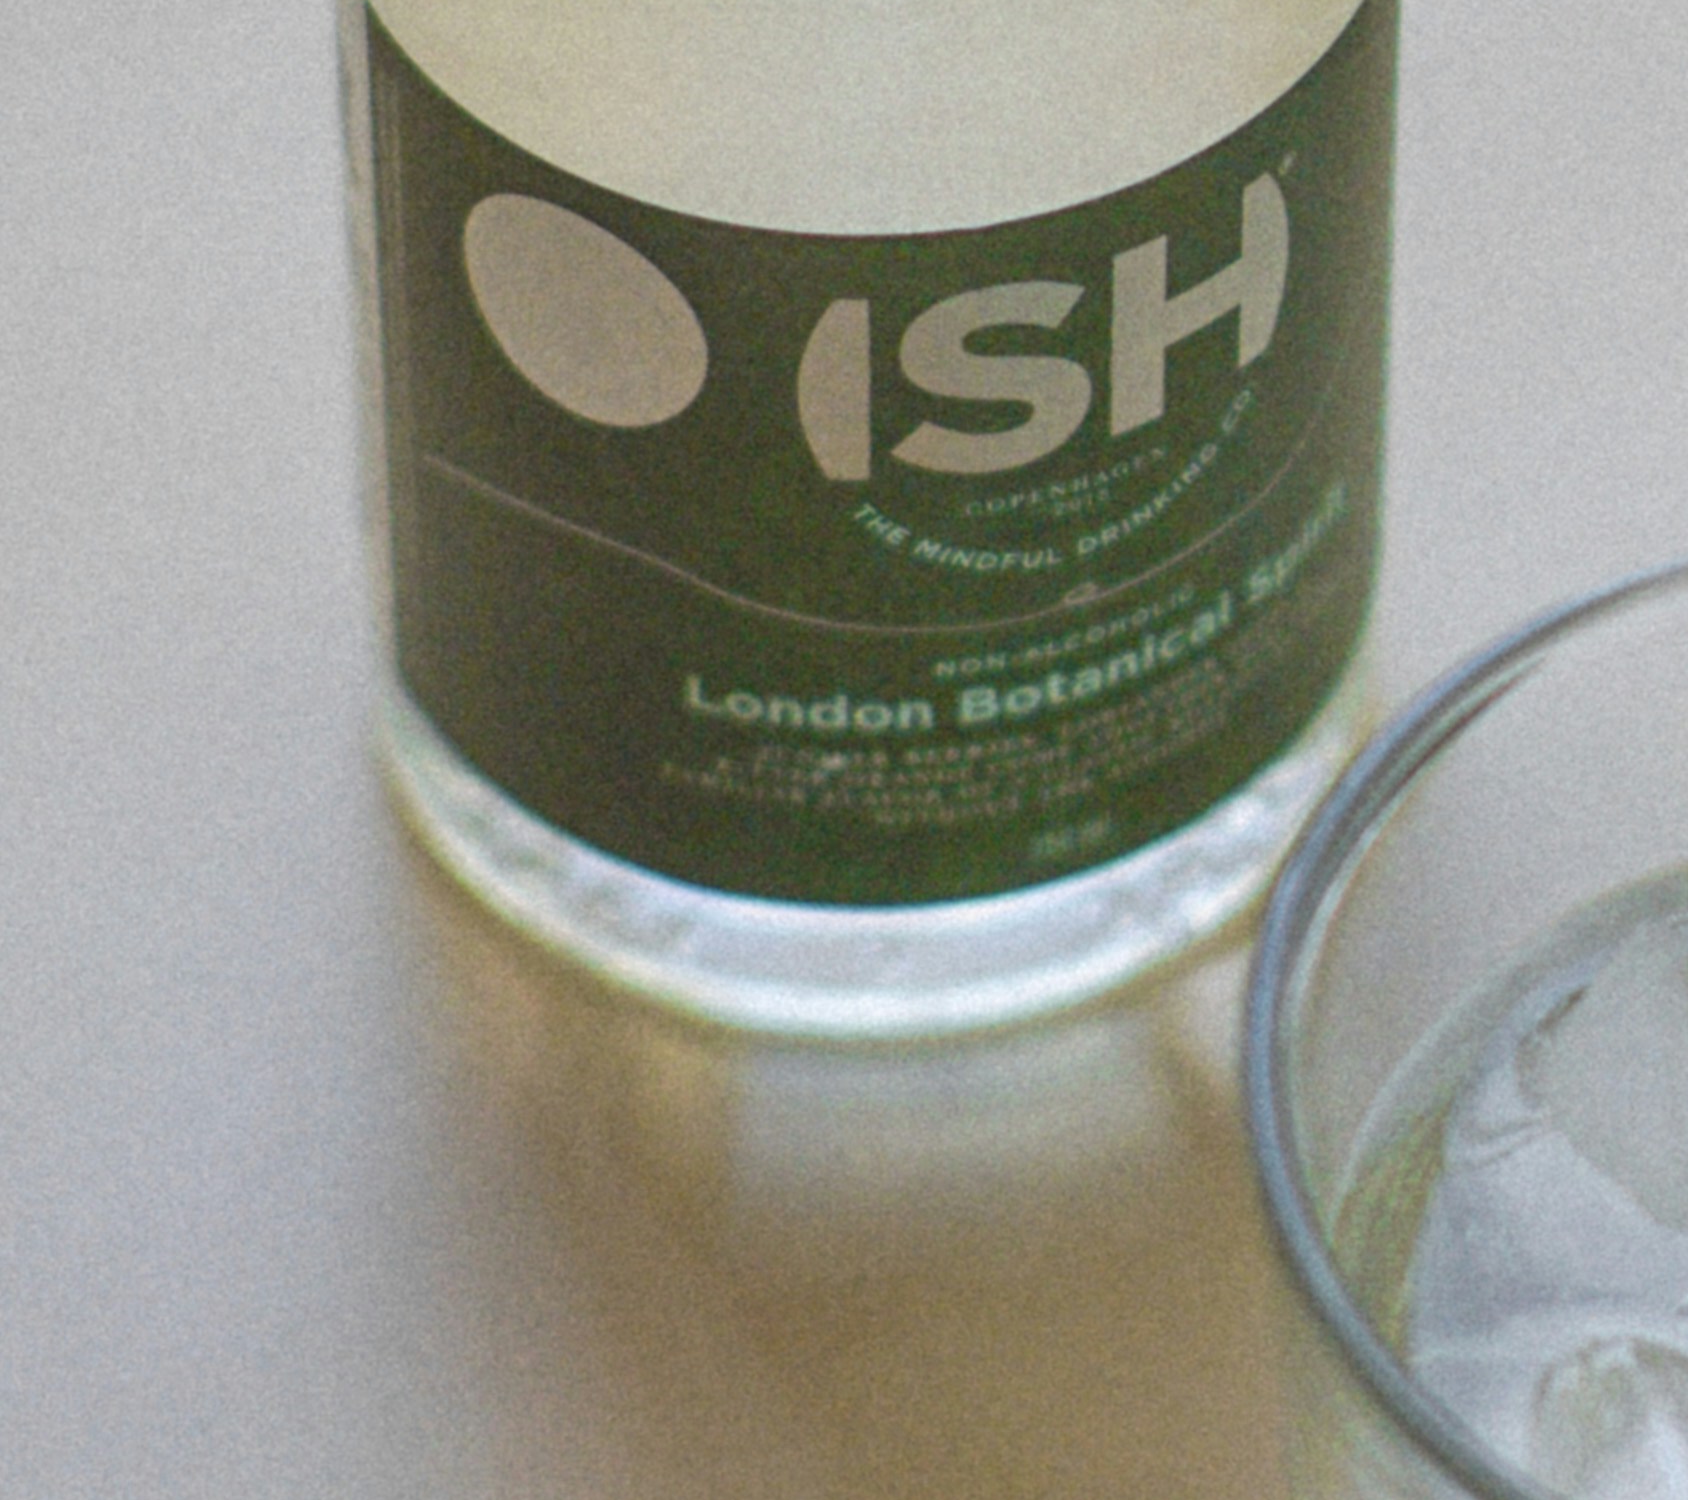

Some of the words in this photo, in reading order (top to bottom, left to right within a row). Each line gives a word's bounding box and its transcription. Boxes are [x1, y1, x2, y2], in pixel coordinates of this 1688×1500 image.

[798, 173, 1289, 482] ISH
[854, 502, 912, 548] THE
[913, 537, 1063, 571] MINDFUL
[1077, 443, 1218, 556] DRINKING
[684, 673, 935, 731] London
[959, 590, 1233, 723] Botanical
